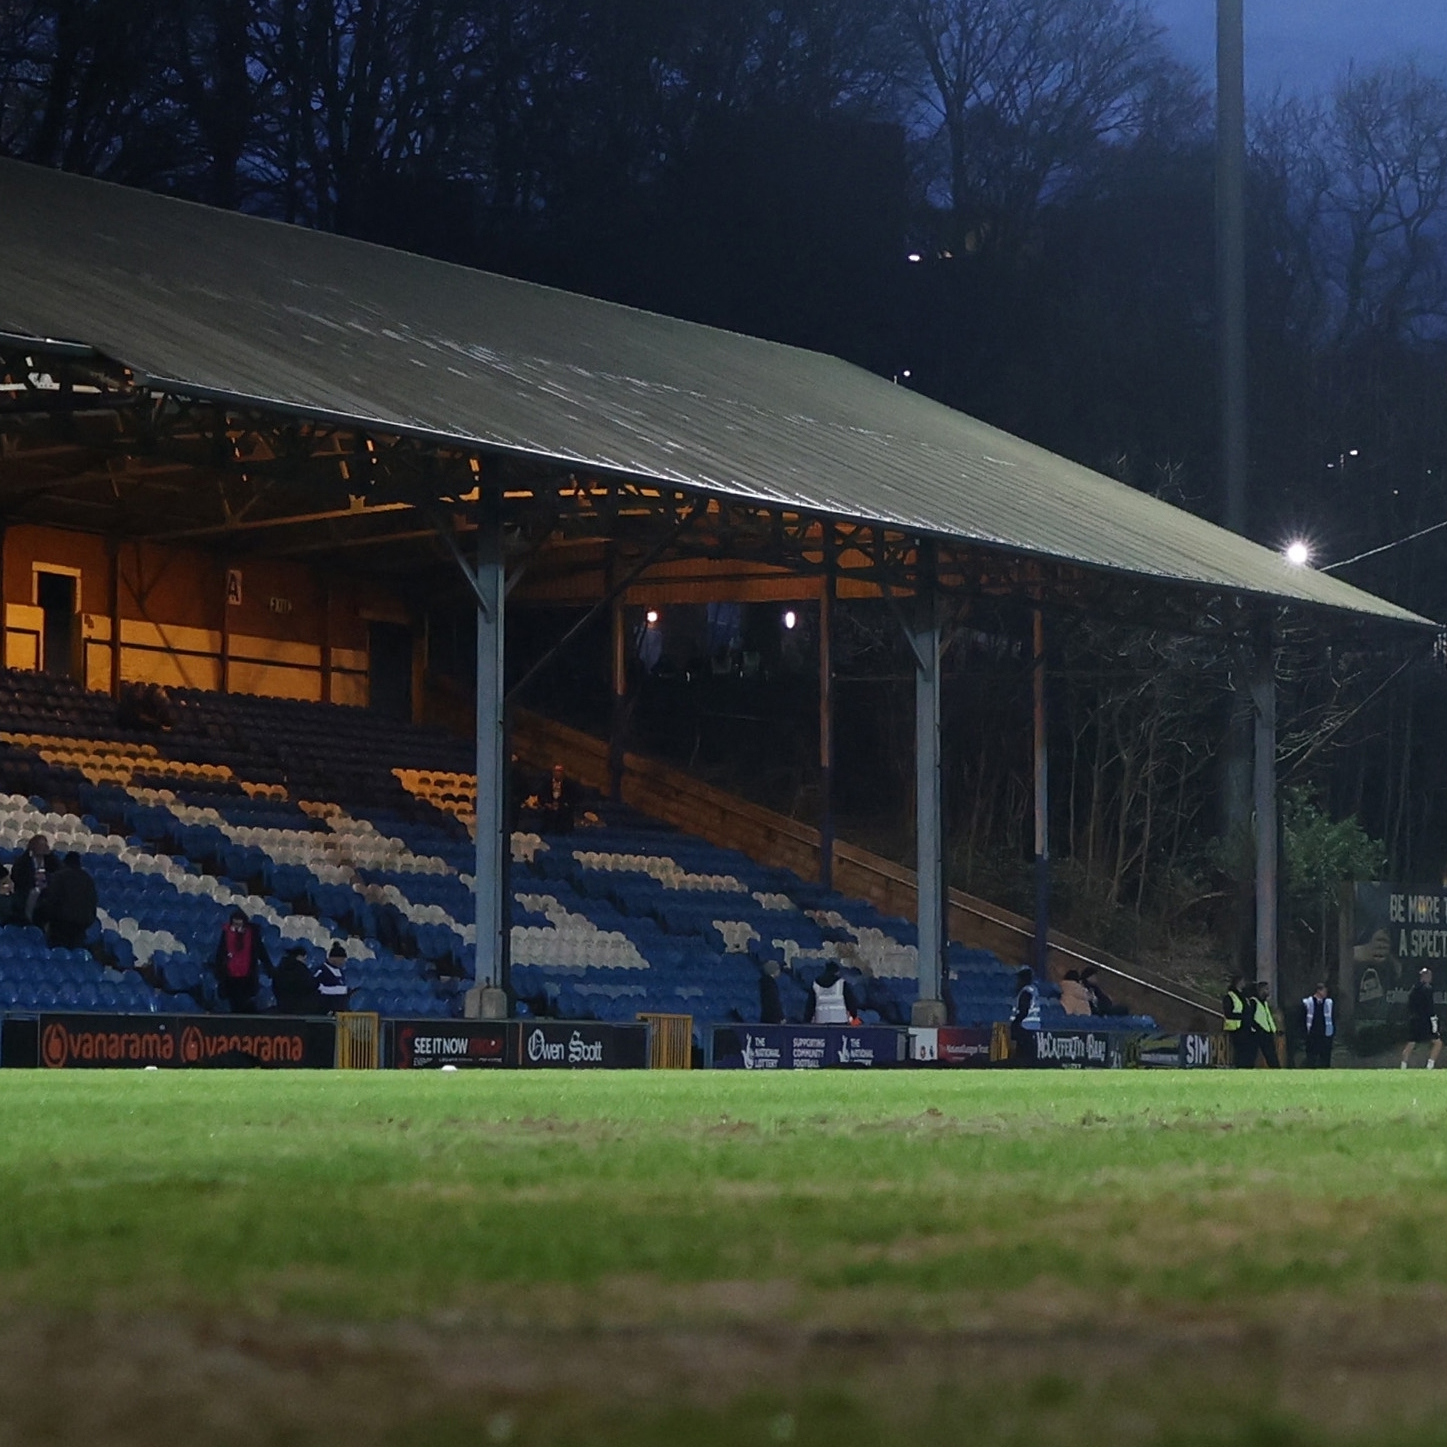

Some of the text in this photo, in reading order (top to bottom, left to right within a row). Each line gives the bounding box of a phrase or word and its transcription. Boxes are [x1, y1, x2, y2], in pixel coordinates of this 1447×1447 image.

[228, 573, 239, 602] A
[1389, 893, 1405, 923] BE
[1408, 895, 1440, 924] MORE
[1398, 929, 1409, 958] A
[69, 1033, 174, 1060] vanarama
[204, 1035, 303, 1062] vanarama
[528, 1029, 565, 1061] Owen
[568, 1030, 603, 1063] Scott
[793, 1048, 825, 1058] COMMUNITY
